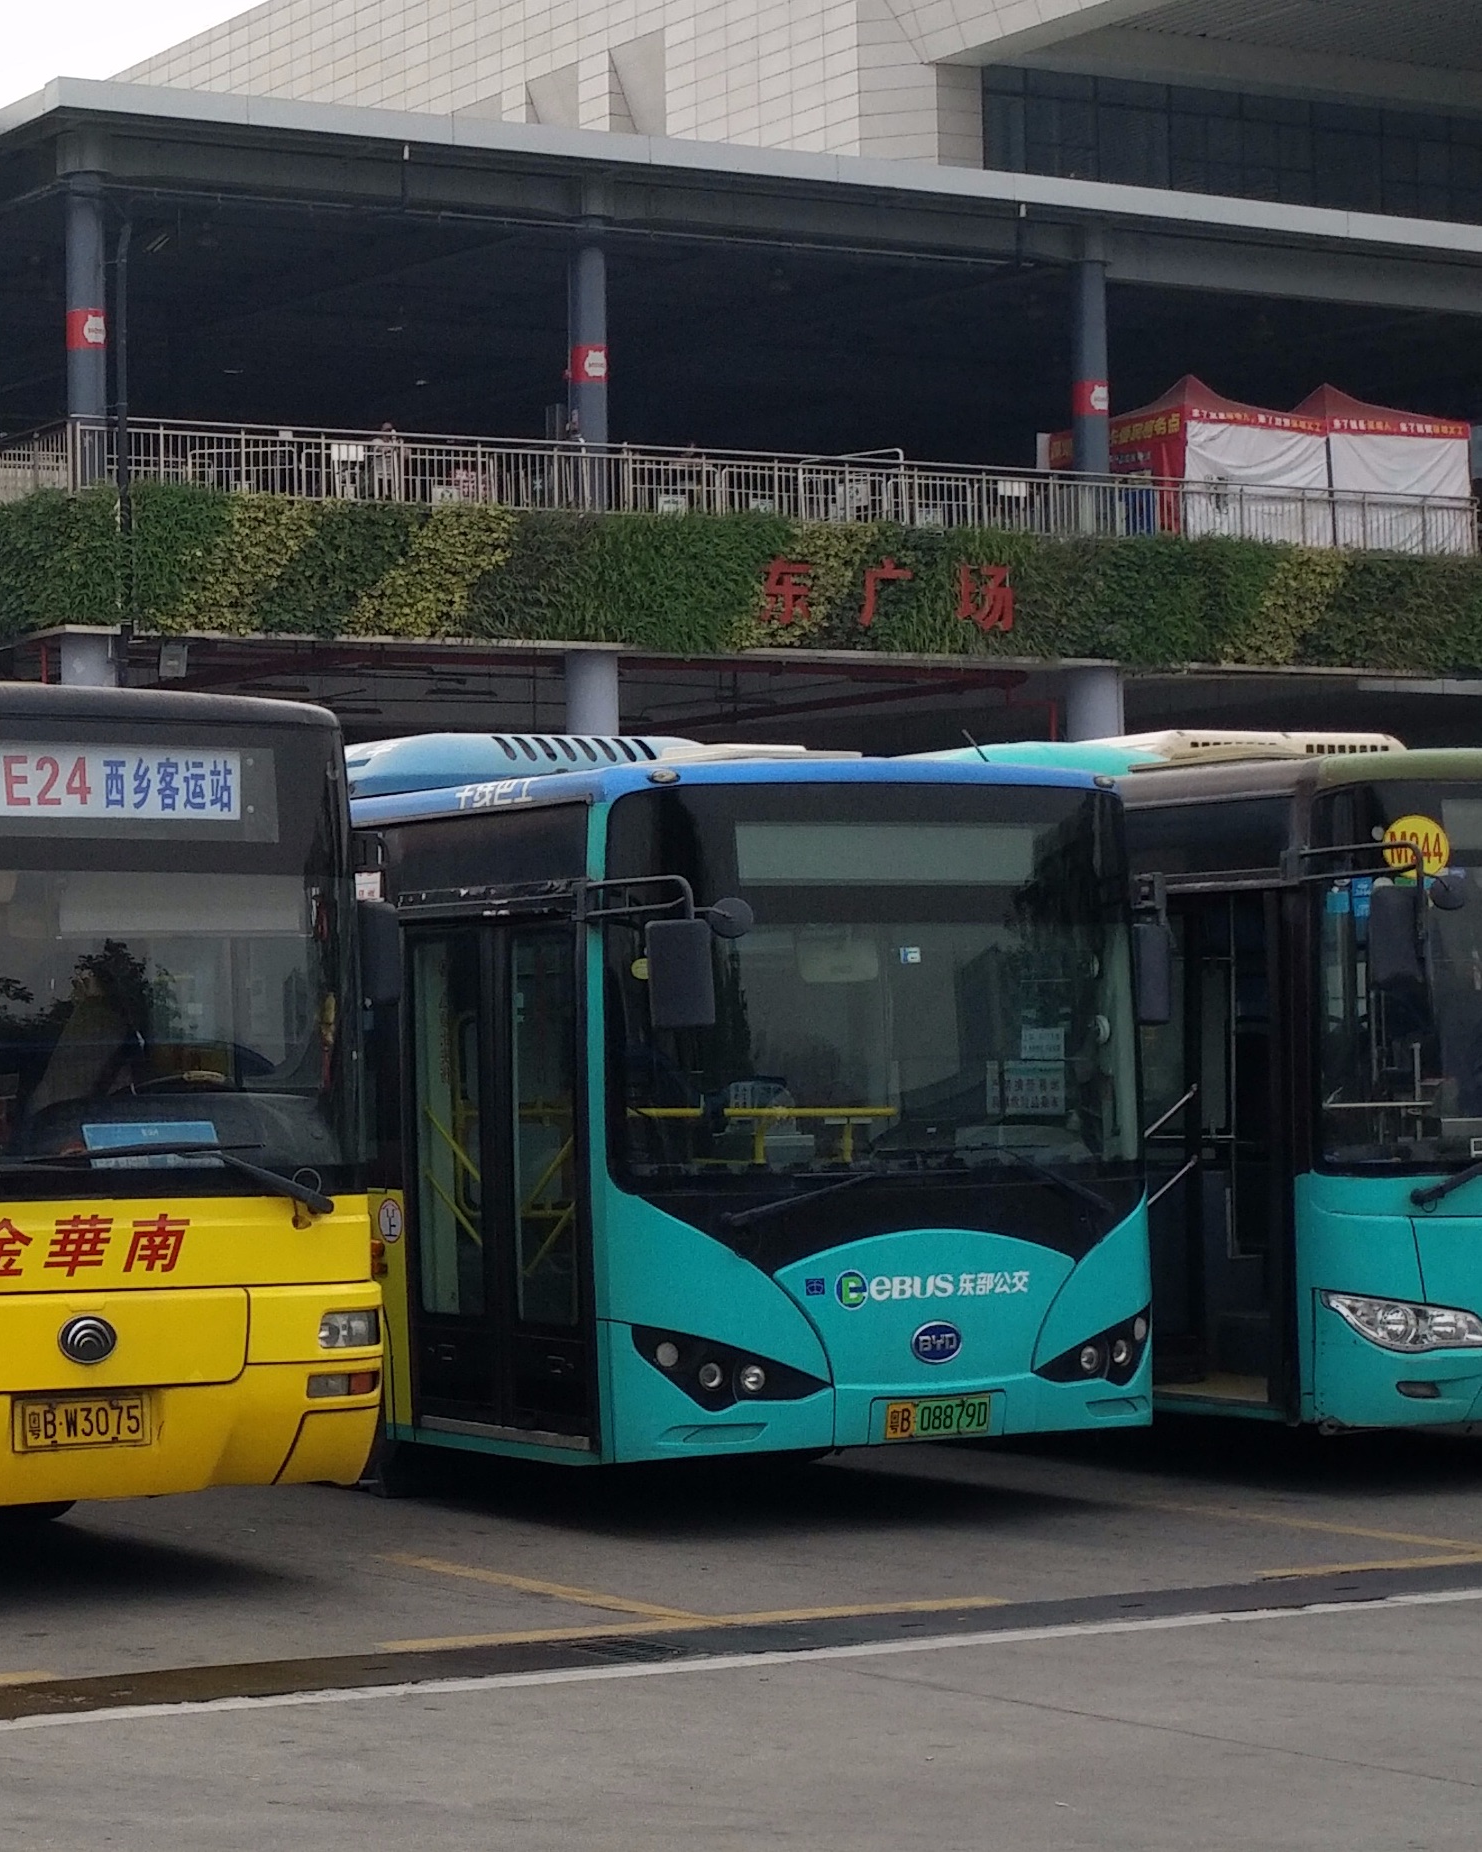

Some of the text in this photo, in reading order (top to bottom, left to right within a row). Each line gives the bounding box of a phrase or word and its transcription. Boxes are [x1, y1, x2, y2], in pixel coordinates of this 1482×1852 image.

[759, 556, 1014, 632] 东广场
[2, 754, 92, 807] E24
[102, 757, 233, 812] 西乡客运站
[957, 1270, 1031, 1296] 东部公交
[918, 1333, 957, 1352] BYD
